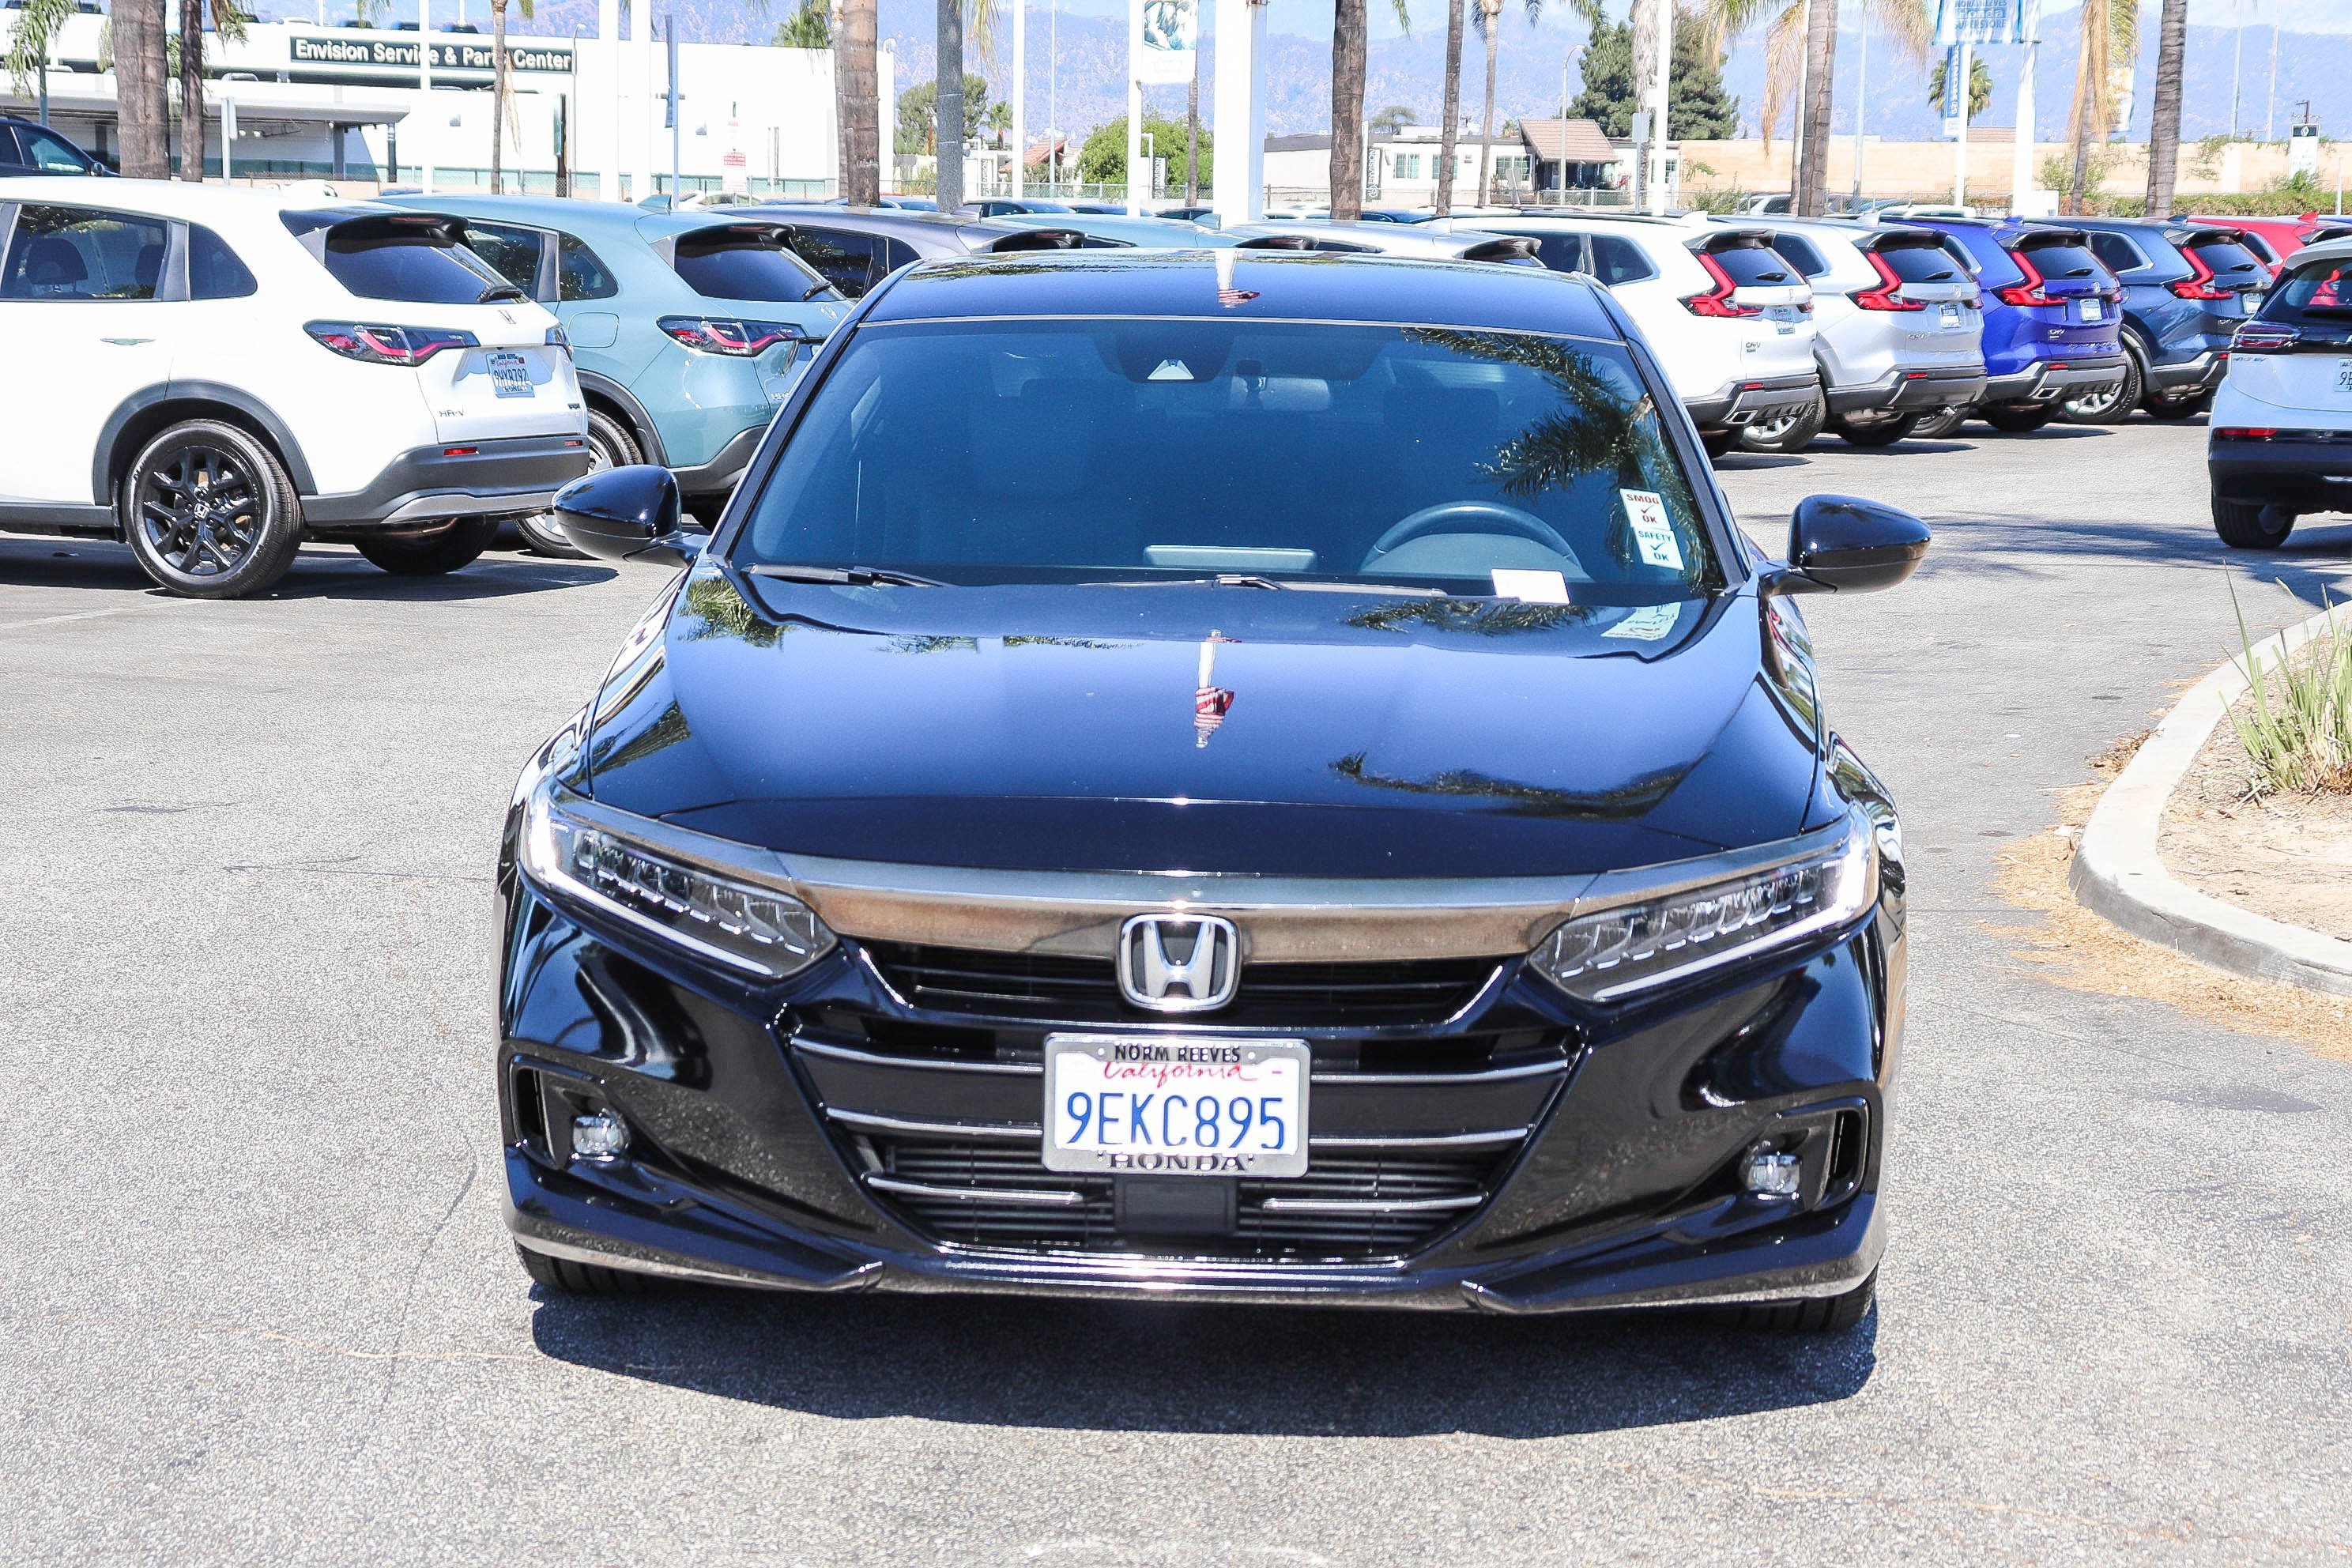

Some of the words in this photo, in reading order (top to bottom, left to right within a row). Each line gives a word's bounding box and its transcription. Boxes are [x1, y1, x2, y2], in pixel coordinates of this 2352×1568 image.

[296, 39, 369, 62] Envision
[373, 42, 439, 65] Servie
[444, 46, 458, 65] &
[514, 49, 572, 70] Center
[1626, 494, 1660, 504] SMOG
[1642, 514, 1657, 523] OK
[1638, 530, 1672, 542] SAFETY
[1653, 552, 1669, 561] OK
[1114, 1045, 1170, 1061] NORM
[1178, 1045, 1241, 1063] REEVES
[1104, 1061, 1258, 1088] California
[1066, 1091, 1285, 1150] 9EKC895
[1108, 1153, 1247, 1171] HONDA
